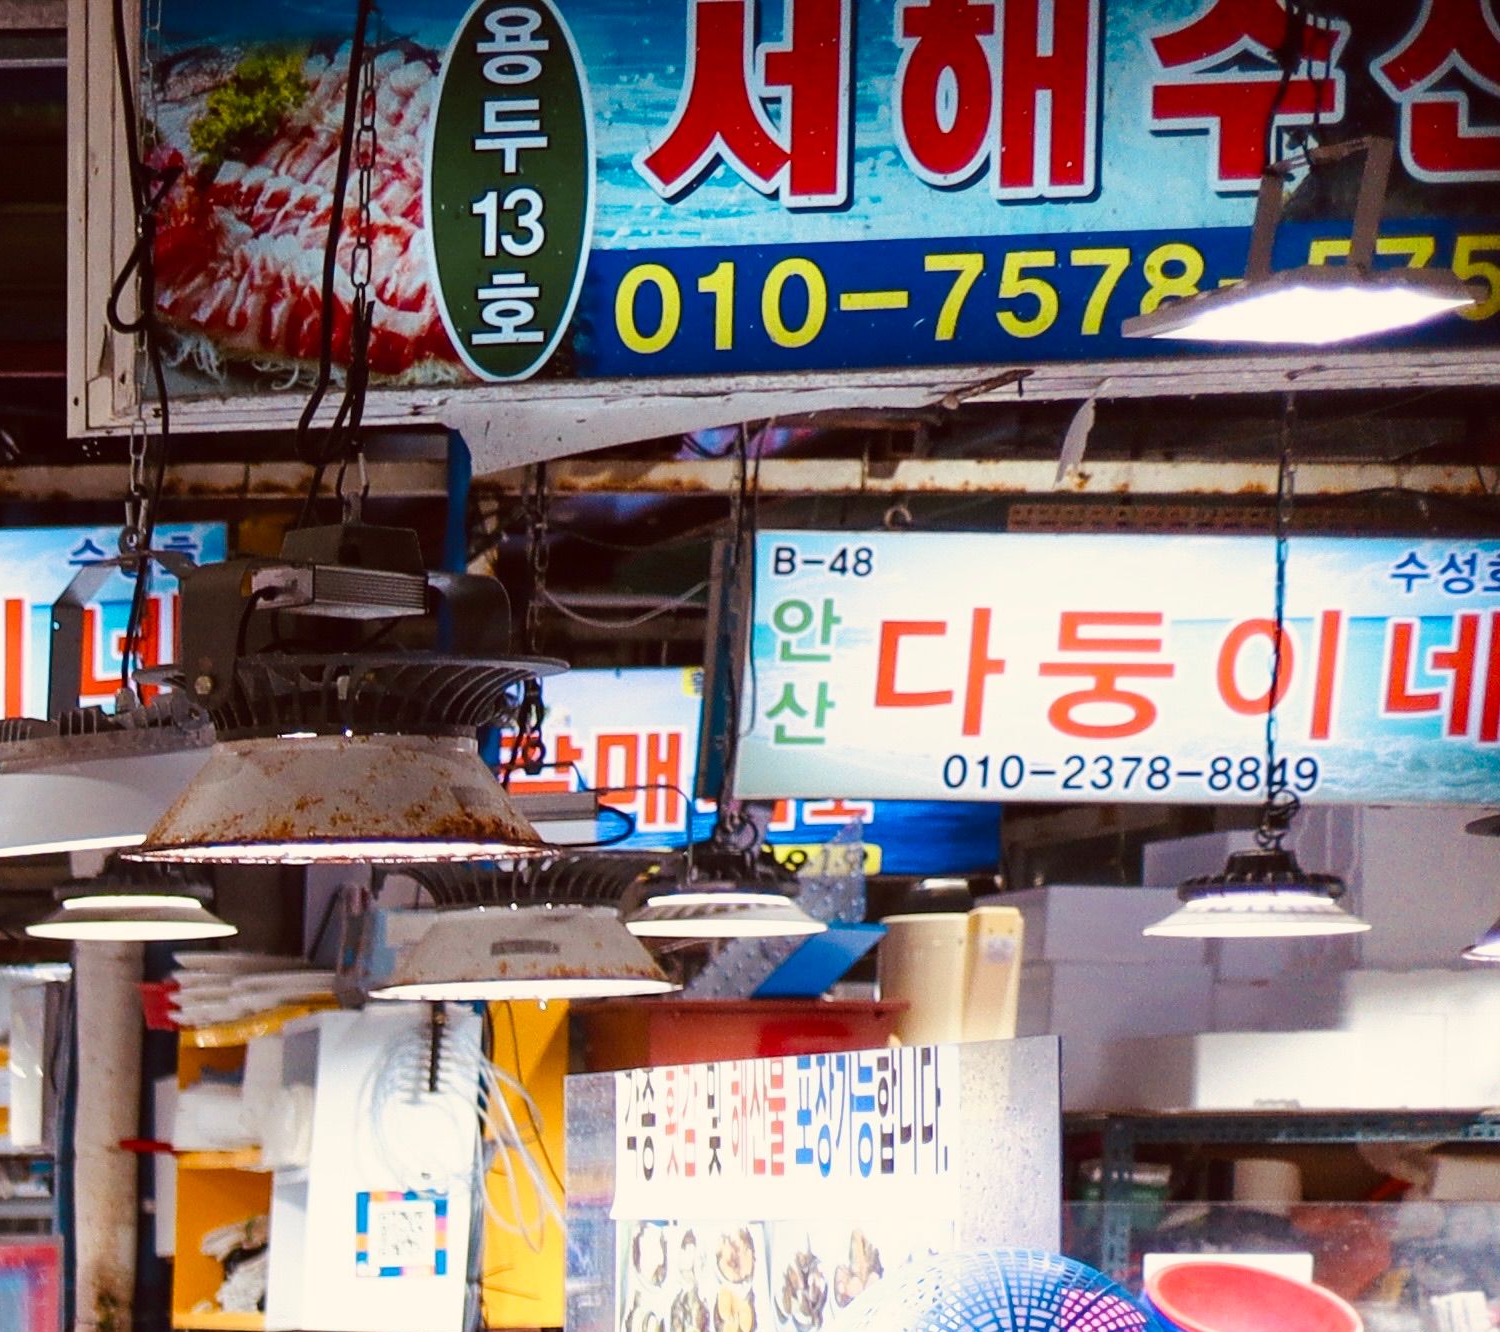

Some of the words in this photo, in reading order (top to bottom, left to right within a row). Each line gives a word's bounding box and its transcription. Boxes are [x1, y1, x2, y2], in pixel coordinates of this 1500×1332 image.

[773, 548, 873, 577] B-48
[765, 596, 842, 746] 안산
[873, 606, 1500, 742] 다둥이네
[943, 755, 1321, 791] 010-2378-8849
[624, 1067, 657, 1182] 각종
[706, 1062, 722, 1177] 및
[731, 1056, 787, 1177] 해산물
[794, 1044, 949, 1178] 포장가능합니다.
